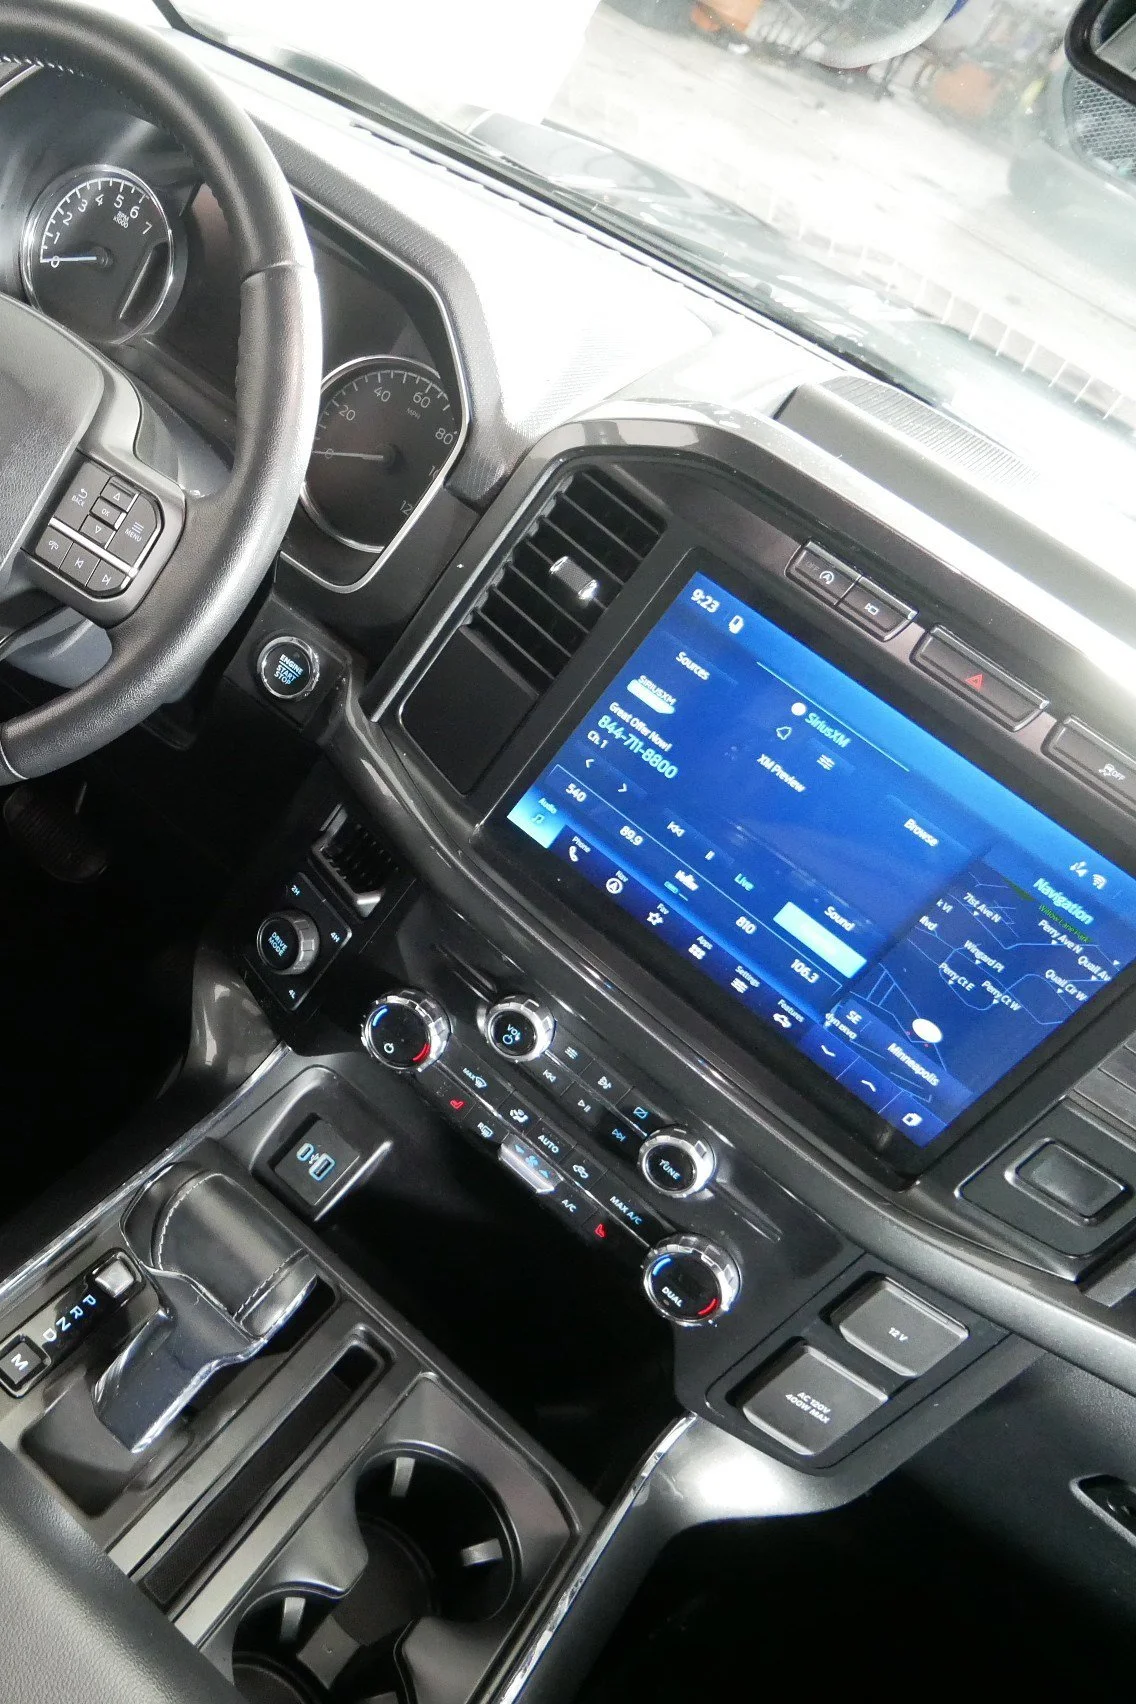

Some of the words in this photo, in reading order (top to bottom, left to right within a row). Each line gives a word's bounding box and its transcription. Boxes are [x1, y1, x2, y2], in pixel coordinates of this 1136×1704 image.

[78, 200, 88, 212] 3
[95, 194, 104, 206] 4
[114, 194, 124, 208] 5
[63, 212, 72, 225] 2
[130, 206, 140, 218] 6
[142, 221, 152, 234] 7
[54, 232, 60, 244] 1
[50, 256, 60, 268] 0
[374, 386, 390, 402] 40
[413, 392, 430, 408] 60
[338, 405, 356, 420] 20
[406, 408, 420, 420] MPH
[435, 428, 454, 444] 80
[102, 508, 110, 517] OK
[400, 500, 414, 516] 12
[125, 528, 142, 542] MENU
[690, 589, 720, 614] 9:23
[276, 664, 296, 682] START
[280, 654, 304, 676] ENGINE
[676, 652, 710, 680] Sources
[274, 672, 292, 684] STOP
[639, 675, 677, 706] SIRIUSXM
[610, 702, 632, 722] Great
[630, 718, 652, 737] Offer
[648, 731, 672, 752] Now!
[804, 712, 852, 749] SiriusXM
[588, 730, 600, 745] Ch.
[600, 740, 609, 748] 1
[598, 715, 678, 778] 844-711-8800
[757, 754, 775, 771] XM
[772, 764, 806, 793] Preview
[1112, 770, 1125, 780] OFF
[566, 783, 586, 802] 540
[538, 798, 558, 814] Audio
[620, 826, 644, 846] 89.9
[904, 818, 939, 846] Browse
[572, 836, 591, 852] Phone
[615, 870, 628, 882] Nav
[734, 873, 755, 892] Live
[291, 885, 300, 896] 2H
[656, 903, 670, 914] Fav
[964, 892, 980, 910] 71st
[977, 902, 993, 917] Ave
[992, 913, 1002, 923] N
[1033, 878, 1094, 924] Navigation
[735, 916, 757, 934] 810
[824, 906, 854, 932] Sound
[271, 932, 288, 950] DRIVE
[330, 932, 340, 943] 4H
[696, 936, 713, 950] Apps
[1038, 920, 1060, 938] Perry
[1058, 934, 1074, 949] Ave
[1072, 944, 1083, 954] N
[268, 937, 284, 956] MODE
[735, 966, 760, 988] Settings
[790, 959, 820, 984] 106.3
[939, 962, 960, 981] Perry
[957, 974, 968, 986] Ct
[966, 981, 976, 992] E
[982, 980, 1004, 999] Perry
[1000, 994, 1012, 1006] Ct
[1009, 1000, 1022, 1012] W
[778, 999, 804, 1022] Features
[846, 1010, 862, 1024] SE
[888, 1042, 940, 1086] Minneapolis
[462, 1068, 476, 1080] MAX
[538, 1134, 560, 1154] AUTO
[659, 1158, 682, 1180] TUNE
[562, 1199, 577, 1212] A/C
[610, 1196, 629, 1214] MAX
[626, 1210, 643, 1226] A/C
[83, 1294, 96, 1306] P
[662, 1286, 682, 1307] DUAL
[70, 1305, 84, 1319] R
[56, 1316, 71, 1332] N
[42, 1328, 57, 1342] D
[11, 1354, 28, 1370] M
[797, 1392, 811, 1402] AC
[786, 1394, 812, 1411] 400W
[809, 1409, 830, 1424] MAX
